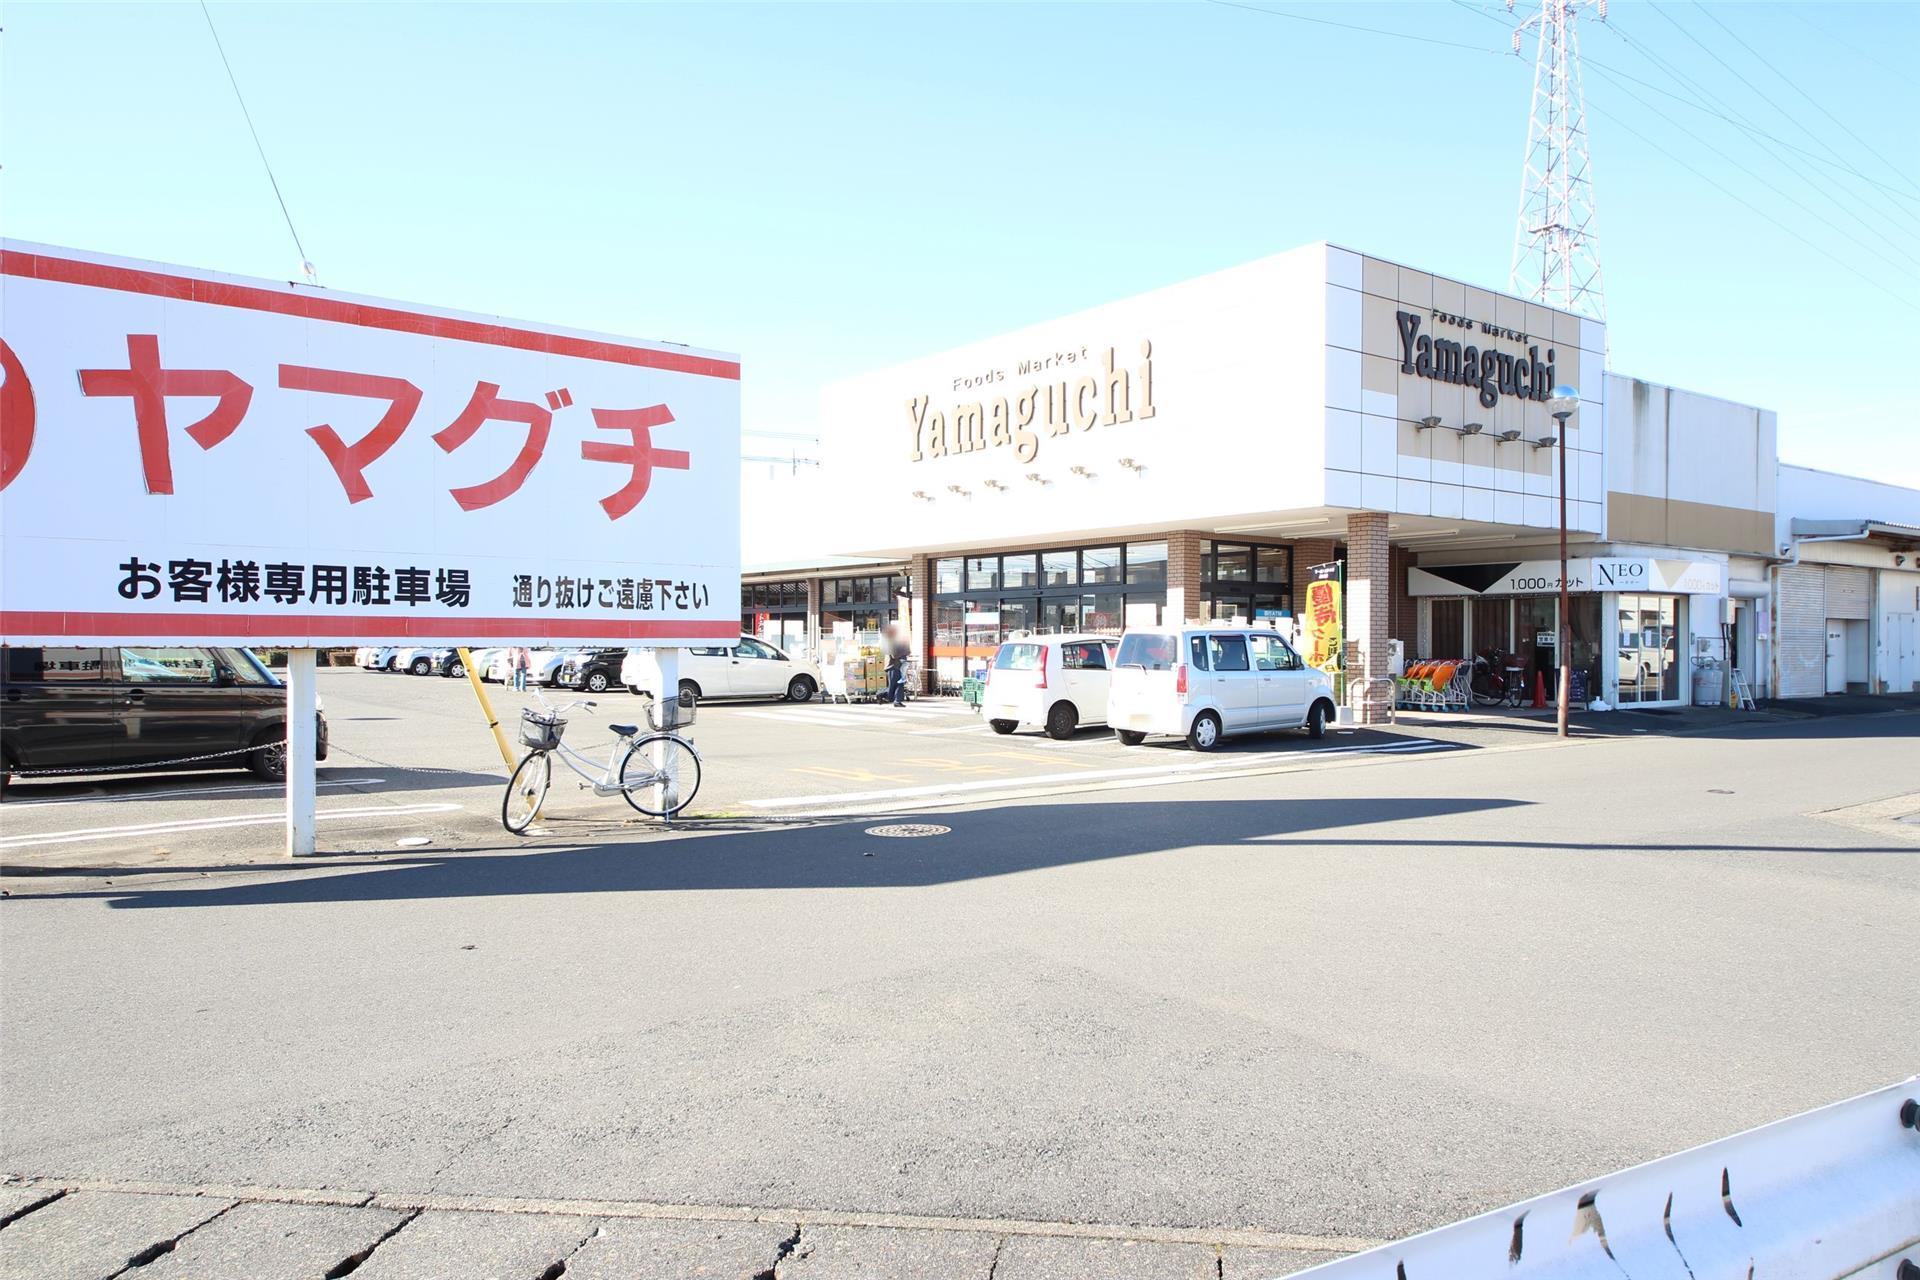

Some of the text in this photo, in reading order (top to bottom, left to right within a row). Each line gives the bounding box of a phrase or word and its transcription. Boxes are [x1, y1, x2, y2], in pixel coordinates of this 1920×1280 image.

[1431, 309, 1529, 345] Foods Market
[952, 345, 1088, 392] Foods Market
[1396, 310, 1556, 409] Yamaguchi
[904, 337, 1156, 464] Yamaguchi
[118, 556, 709, 611] お客様専用駐車場 通り抜けご遠慮下さい
[1597, 563, 1644, 586] NEO
